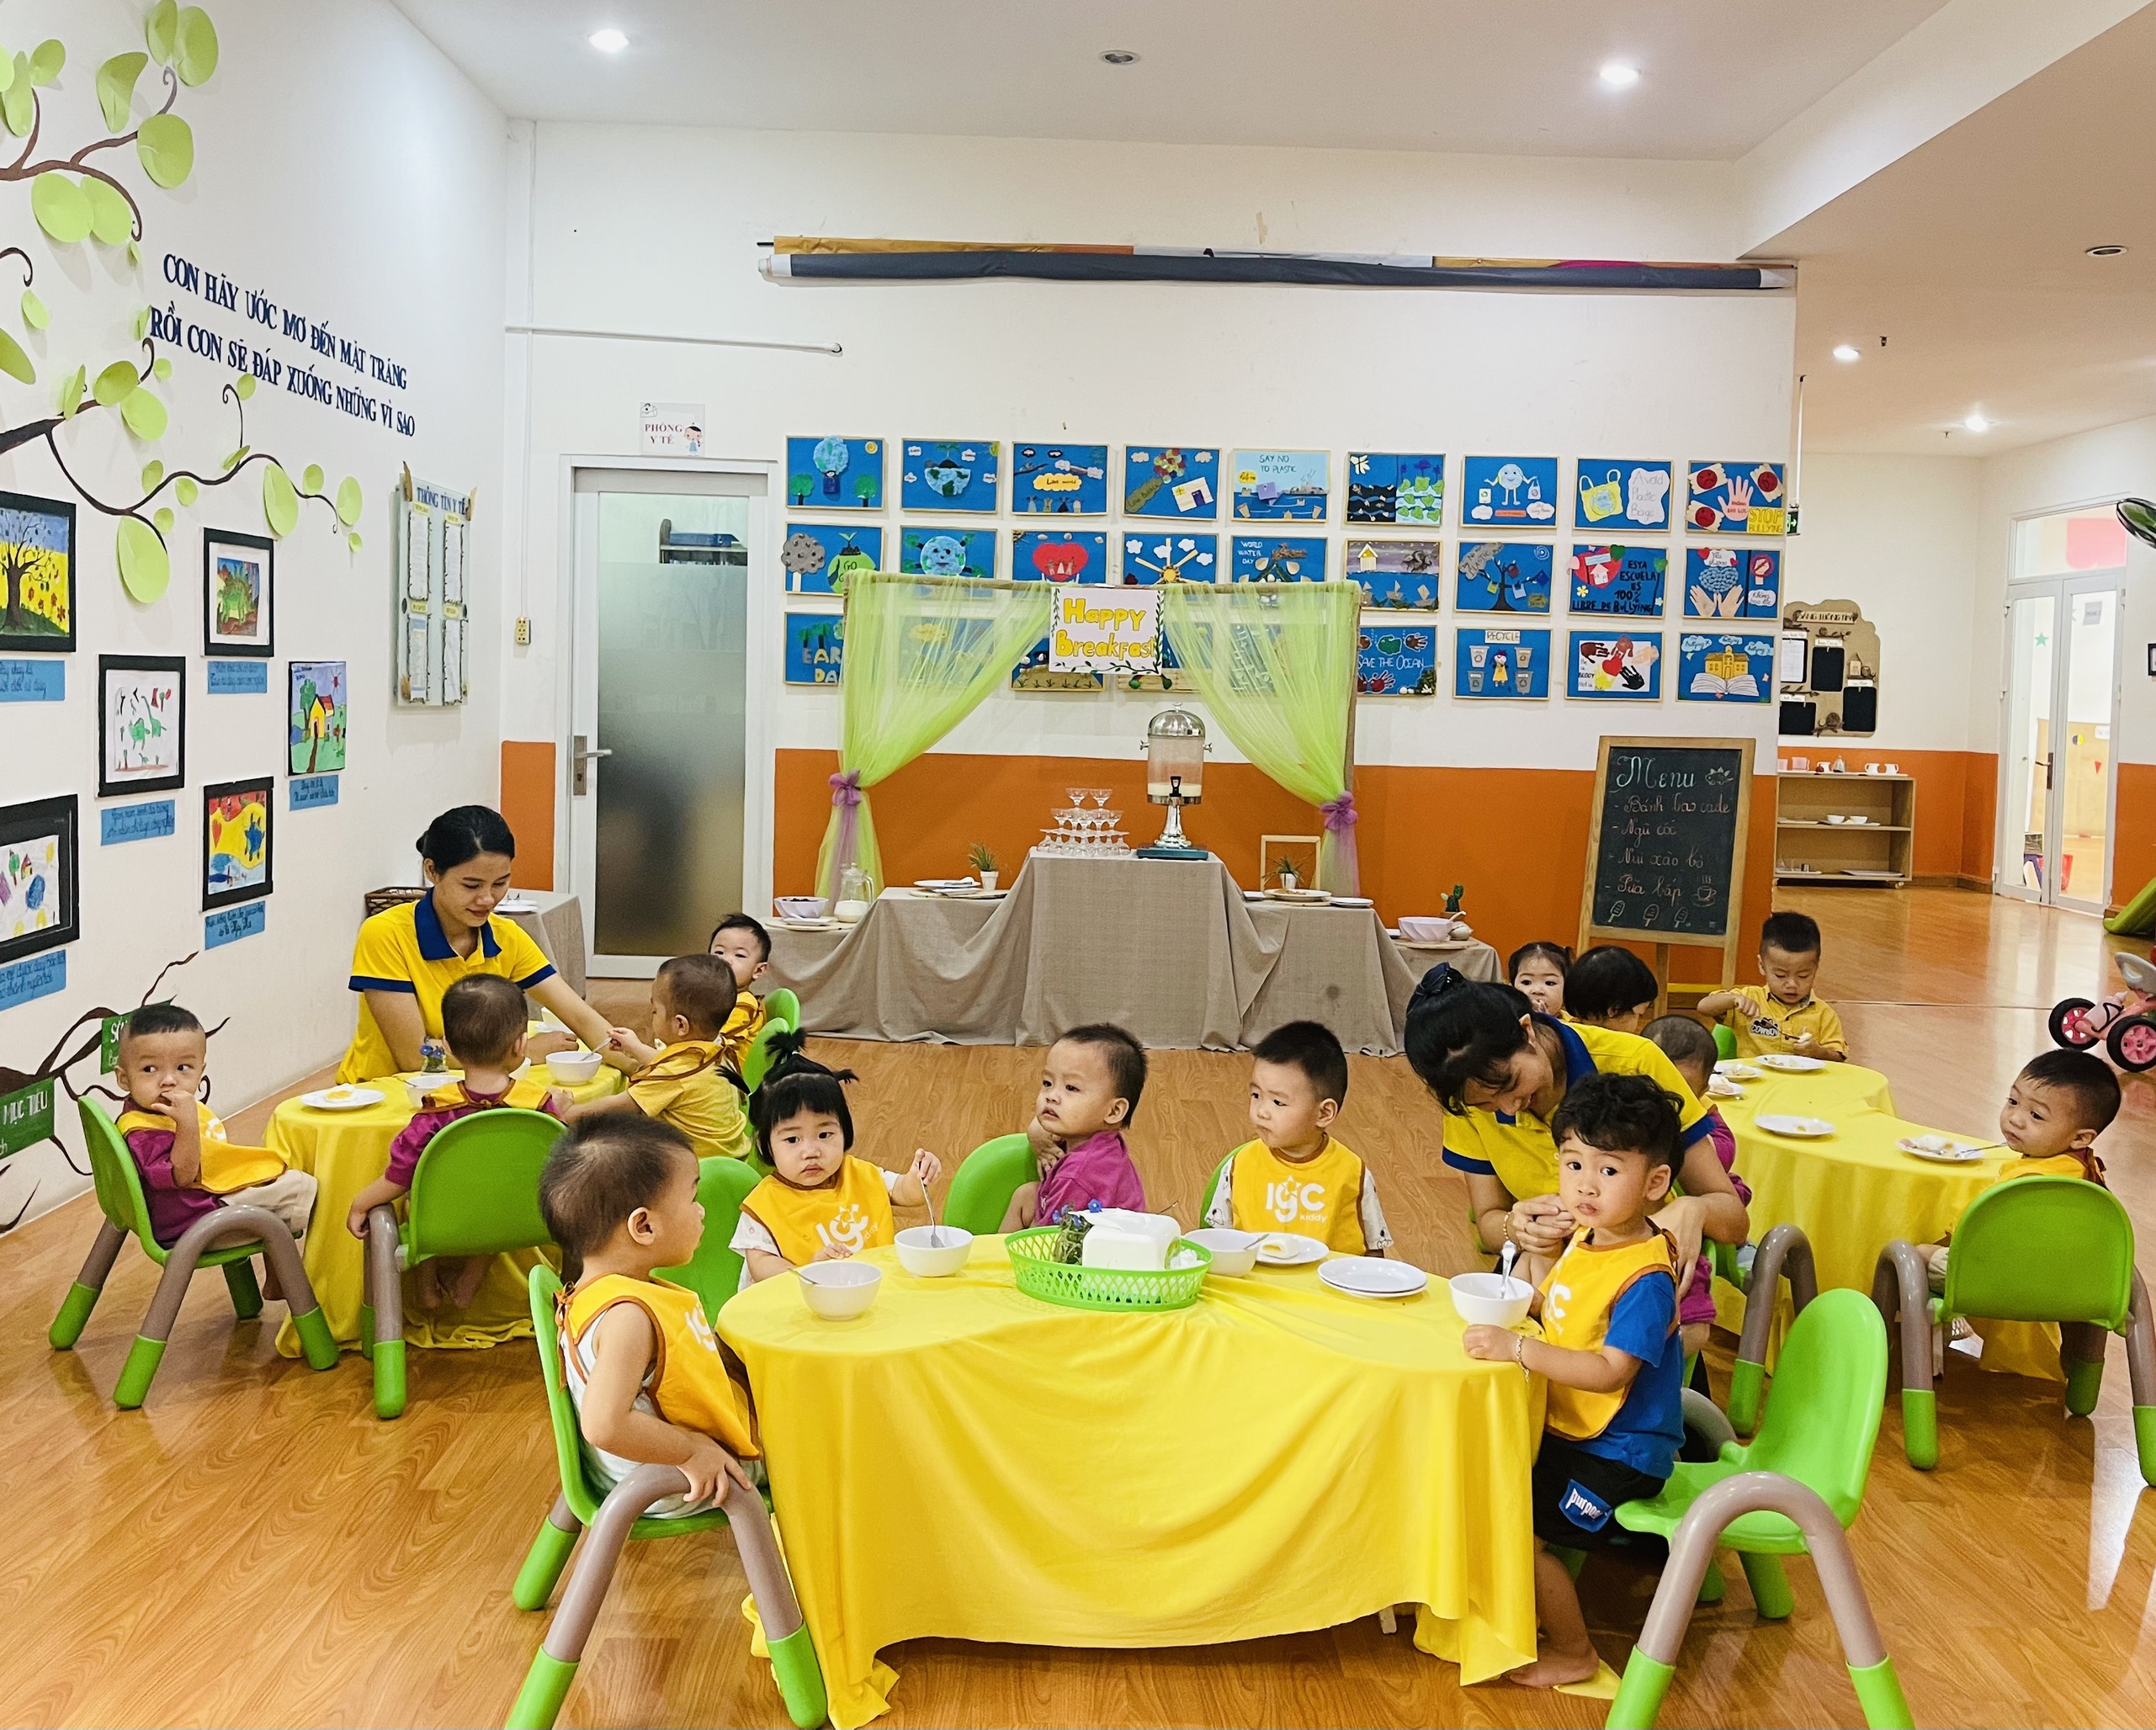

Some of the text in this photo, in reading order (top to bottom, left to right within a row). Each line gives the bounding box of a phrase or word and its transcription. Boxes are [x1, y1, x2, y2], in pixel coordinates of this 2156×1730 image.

[163, 253, 200, 295] CON
[149, 300, 183, 348] RỒI
[187, 324, 223, 364] CON
[252, 348, 283, 386] ĐÁP
[286, 364, 333, 406] XUỐNG
[335, 385, 377, 422] NHỮNG
[380, 398, 393, 429] VÌ
[396, 411, 416, 438] SAO
[650, 435, 658, 444] Y
[1259, 454, 1290, 463] SAY NO
[1272, 465, 1297, 474] PLASTIC
[1631, 503, 1654, 522] Bags
[1749, 507, 1784, 524] STOP
[1749, 523, 1783, 533] BULLYING
[843, 561, 858, 570] GO
[1628, 560, 1647, 570] ESTA
[1619, 572, 1656, 581] ESCUELA
[1631, 581, 1642, 591] ES
[1572, 600, 1596, 610] LIBRE
[1601, 602, 1612, 610] DE
[1063, 598, 1147, 631] Happy
[1487, 631, 1519, 641] RECYCLE
[1055, 629, 1155, 661] Breakfast
[802, 645, 842, 665] EAR
[1378, 657, 1394, 667] THE
[1396, 655, 1424, 671] OCEAN
[815, 668, 839, 683] DA
[1609, 756, 1696, 793] Menu
